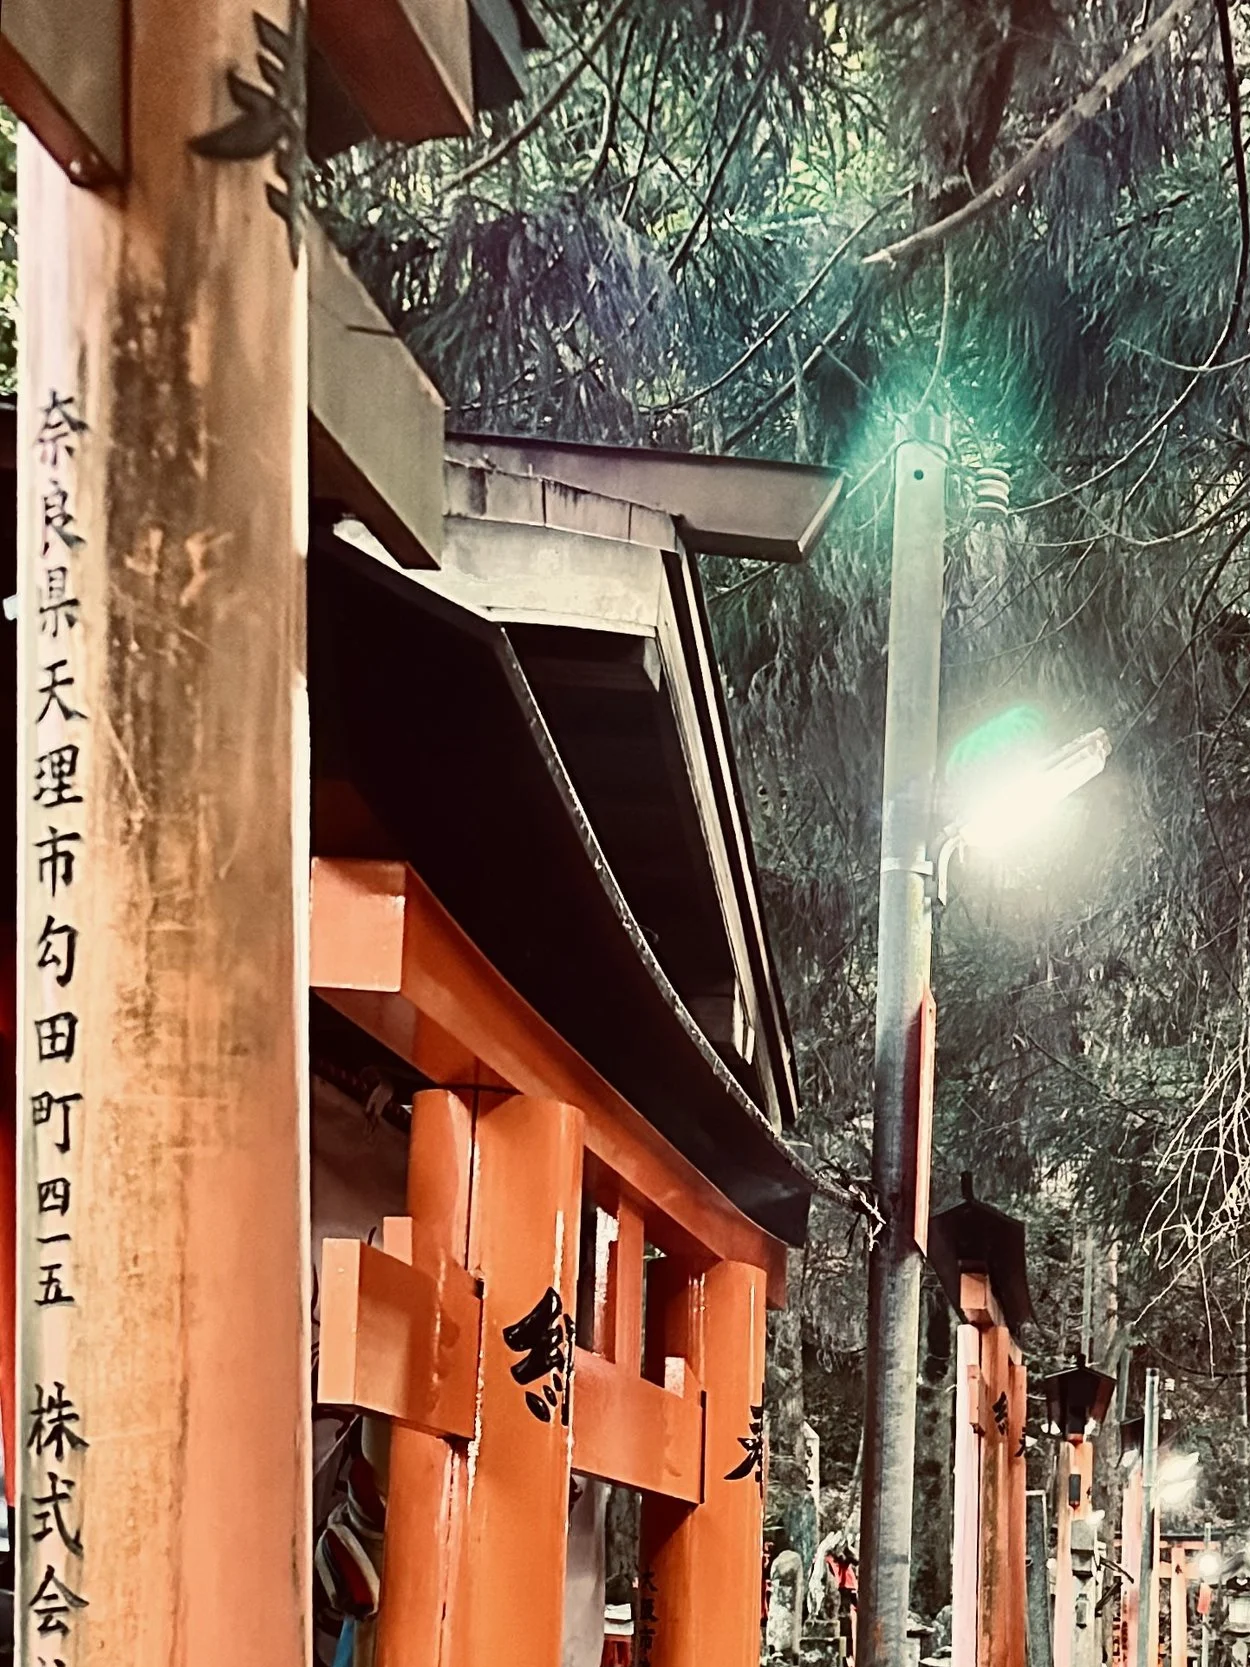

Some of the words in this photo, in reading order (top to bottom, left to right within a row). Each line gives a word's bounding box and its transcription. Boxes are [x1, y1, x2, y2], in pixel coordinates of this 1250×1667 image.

[31, 388, 87, 1306] 奈良県天理市勾田町四一五
